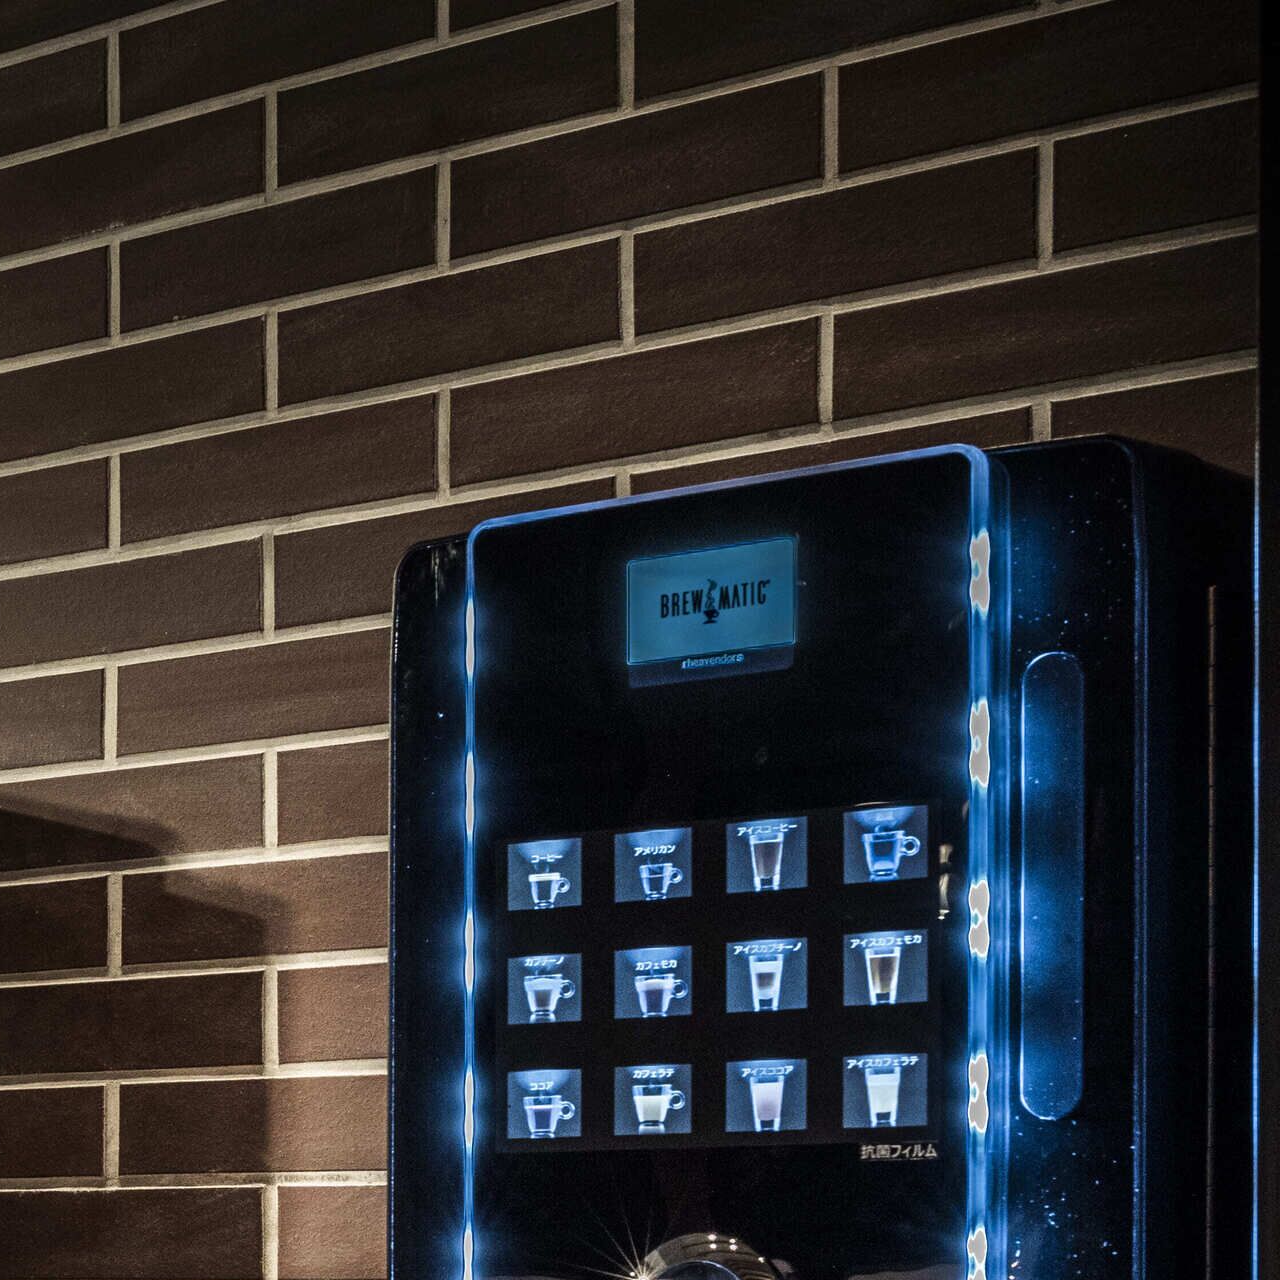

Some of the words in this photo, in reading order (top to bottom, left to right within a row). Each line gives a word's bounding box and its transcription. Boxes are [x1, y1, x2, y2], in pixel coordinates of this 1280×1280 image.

[660, 590, 703, 618] BREW
[719, 580, 767, 610] MATIC
[737, 823, 797, 836] アイスコーヒー
[634, 845, 676, 856] アメリカン
[531, 854, 563, 863] コーヒー
[850, 935, 922, 948] アイスカフェモカ
[635, 959, 677, 971] カフェモカ
[847, 1056, 919, 1069] アイスカフェラテ
[632, 1068, 674, 1079] カフェラテ
[741, 1065, 794, 1077] アイスココア
[529, 1081, 554, 1091] ココア
[860, 1144, 938, 1160] 抗菌フィルム
